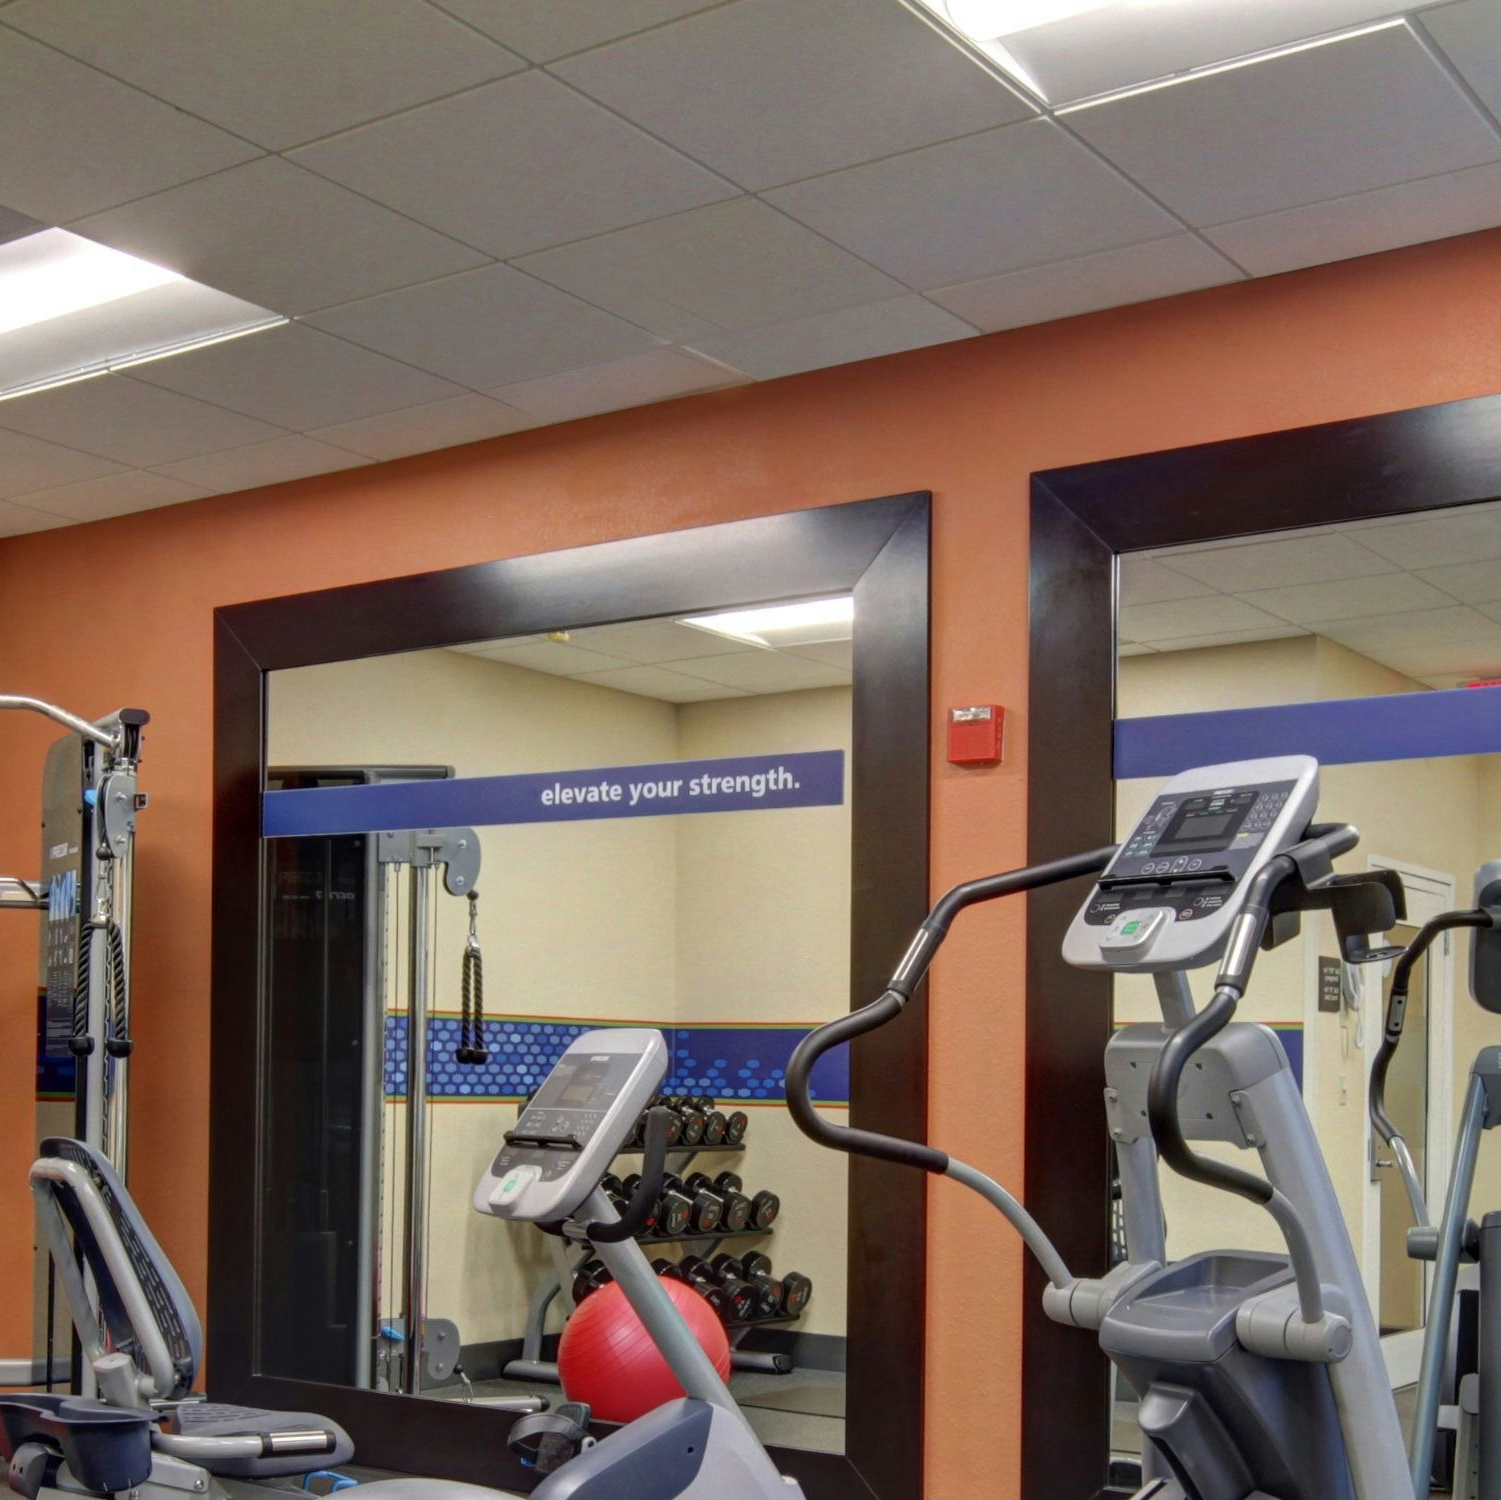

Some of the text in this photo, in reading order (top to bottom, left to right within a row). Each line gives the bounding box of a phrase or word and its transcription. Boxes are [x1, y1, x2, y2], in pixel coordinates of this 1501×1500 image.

[540, 766, 800, 806] elevate your strength.
